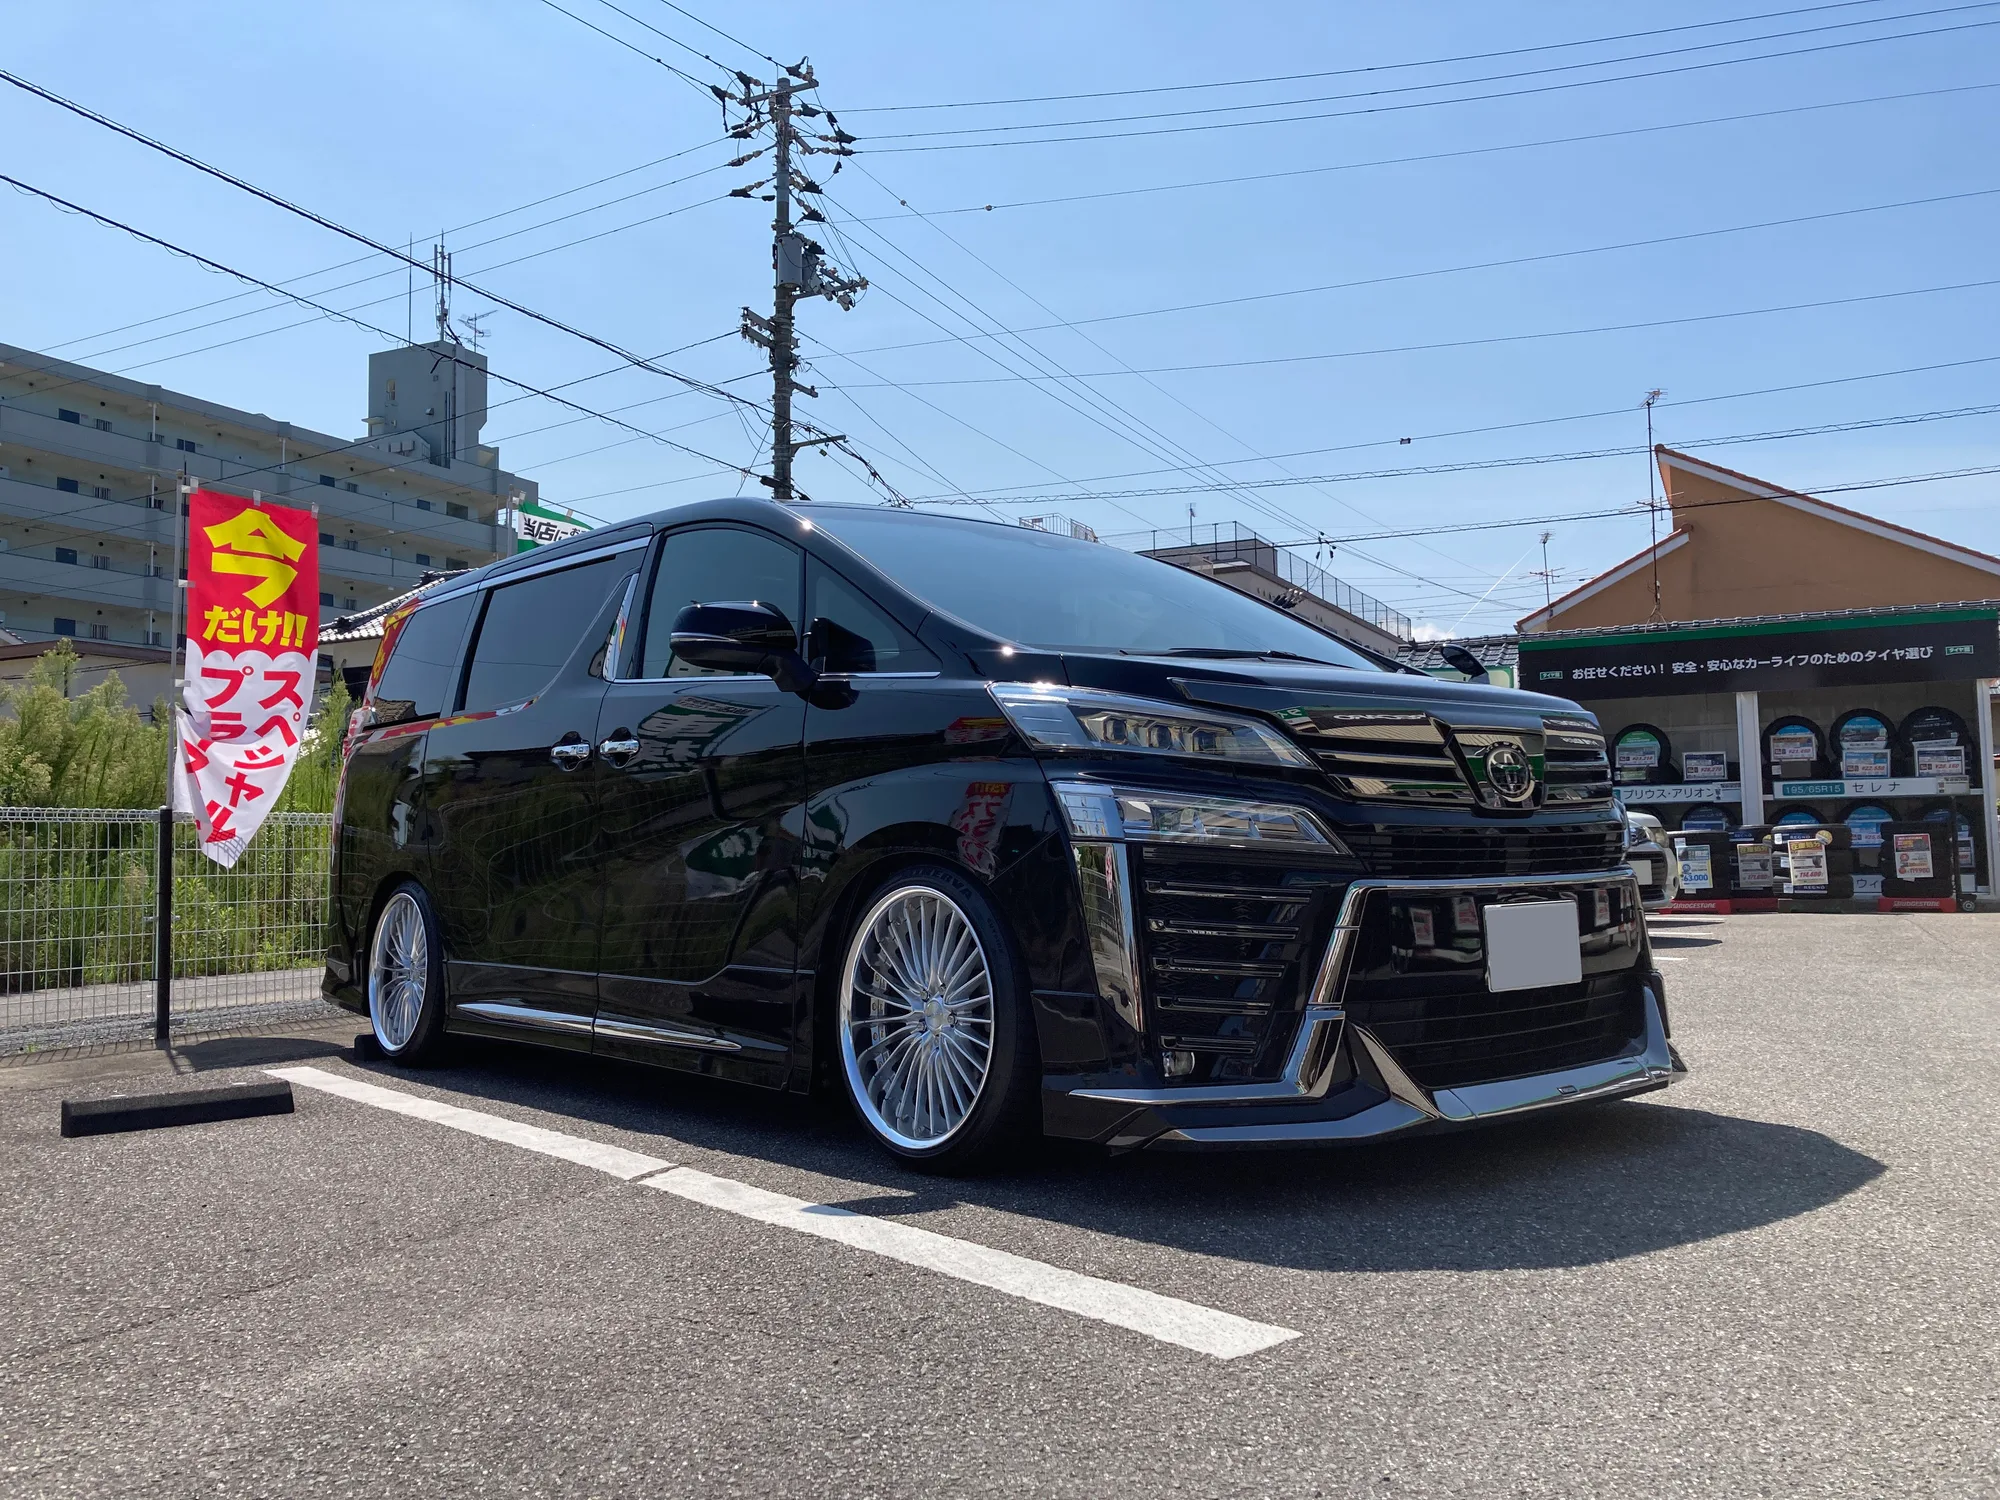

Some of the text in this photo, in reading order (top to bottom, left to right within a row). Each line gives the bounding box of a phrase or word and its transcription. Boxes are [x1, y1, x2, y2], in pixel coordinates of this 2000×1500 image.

[203, 508, 307, 609] 今
[203, 605, 308, 648] だけ!!
[1671, 646, 1934, 675] 安全・安心なカーライフのためのタイヤ選び
[205, 671, 304, 843] スペシャル
[1623, 788, 1715, 800] プリウス・アリオン
[1785, 784, 1842, 795] 195/65R15
[1852, 781, 1901, 793] セレナ
